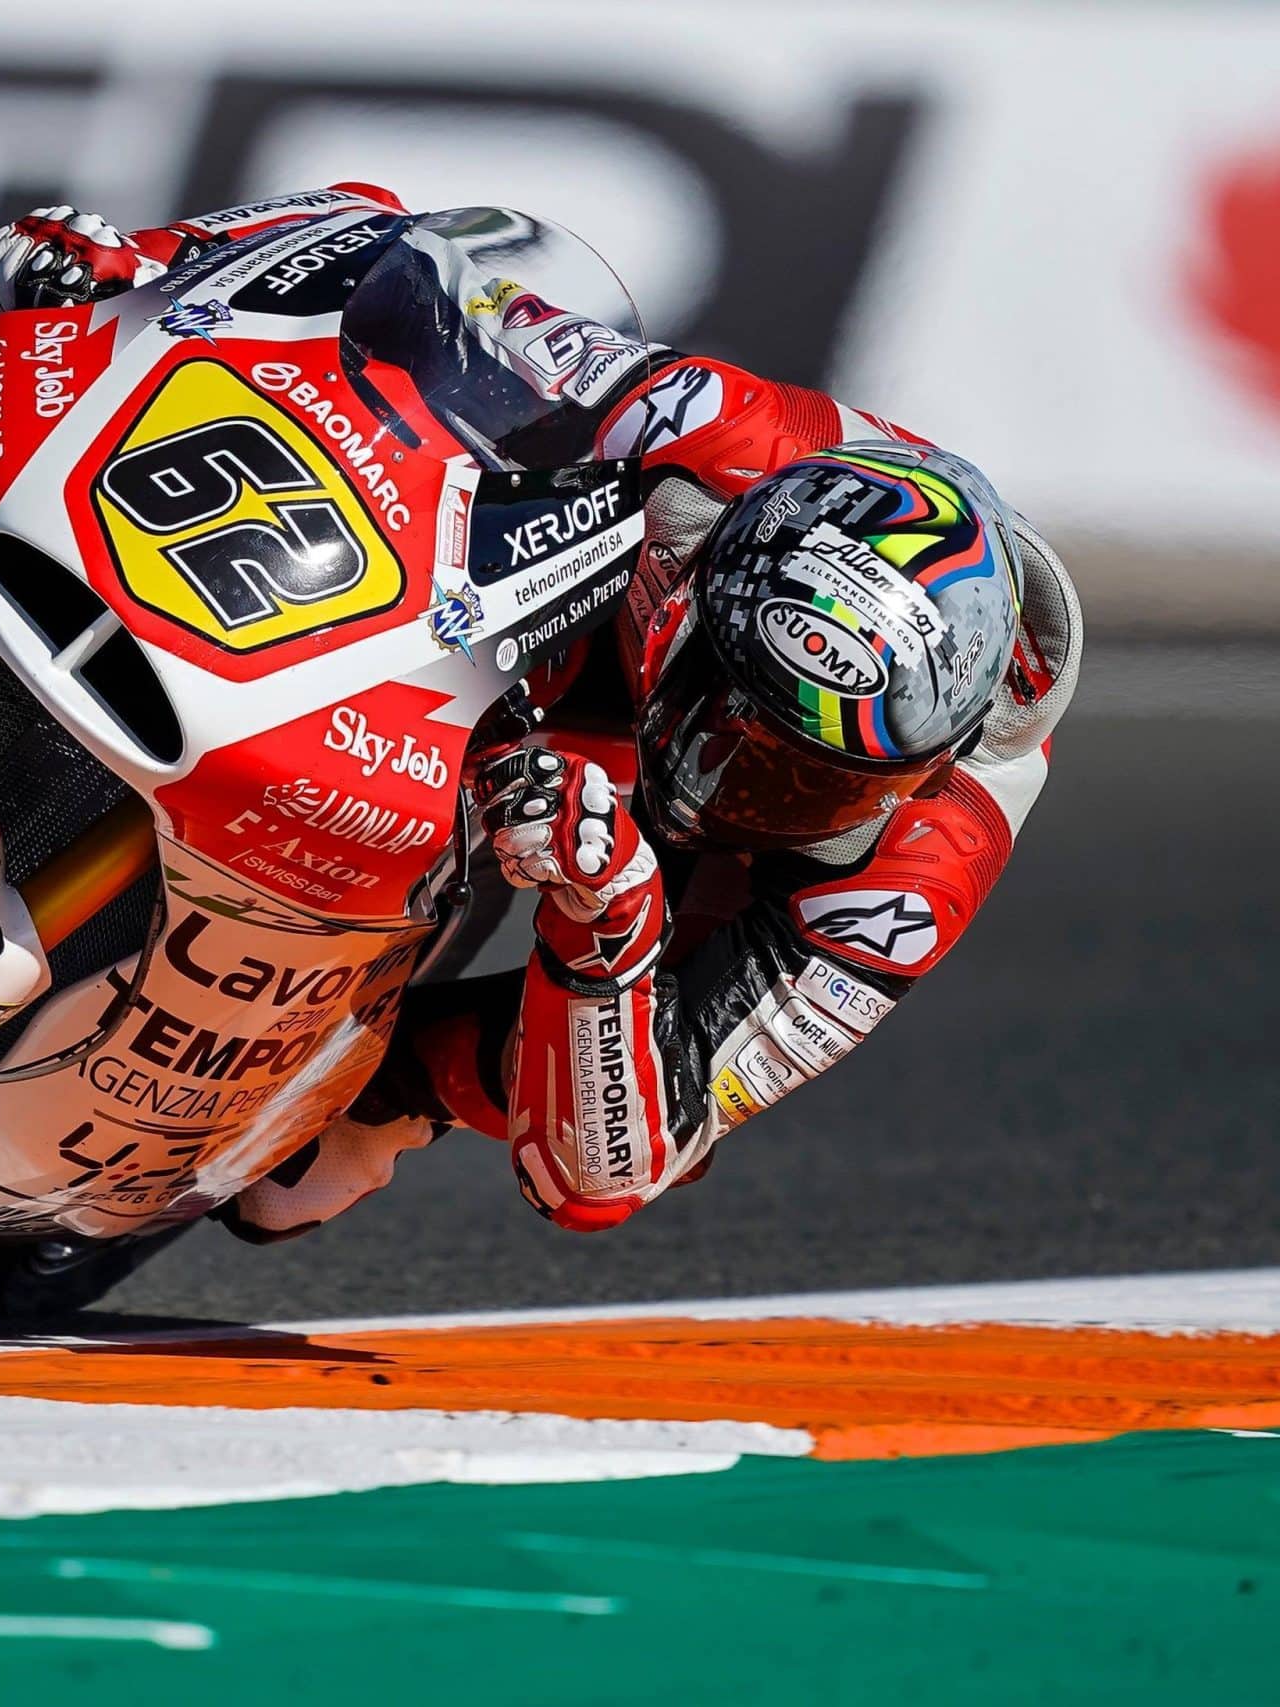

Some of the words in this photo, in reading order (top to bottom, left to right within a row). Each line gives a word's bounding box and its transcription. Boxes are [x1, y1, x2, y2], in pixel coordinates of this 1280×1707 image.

[159, 262, 212, 293] PIETRO
[209, 271, 231, 288] SA
[264, 225, 393, 296] XERJOFF
[20, 320, 79, 365] Sky
[34, 366, 75, 419] Job
[287, 380, 412, 532] BAOMARC
[98, 416, 368, 632] 62
[503, 479, 620, 567] XERJOFF
[514, 535, 609, 606] teknoimpianti
[609, 532, 624, 552] SA
[518, 613, 568, 654] TENUTA
[569, 597, 591, 624] SAN
[592, 569, 630, 609] PIETRO
[801, 562, 916, 653] ALLEMANOTIME.COM
[771, 604, 875, 696] SUOMY
[323, 705, 396, 778] Sky
[390, 733, 450, 791] Job
[302, 788, 437, 855] LIONLAP
[243, 855, 306, 891] SWISS
[262, 836, 382, 890] Axion
[576, 1018, 593, 1079] AGENZIA
[580, 1081, 596, 1106] PER
[582, 1107, 597, 1119] IL
[596, 993, 634, 1179] TEMPORARY
[583, 1122, 602, 1176] LAVORO
